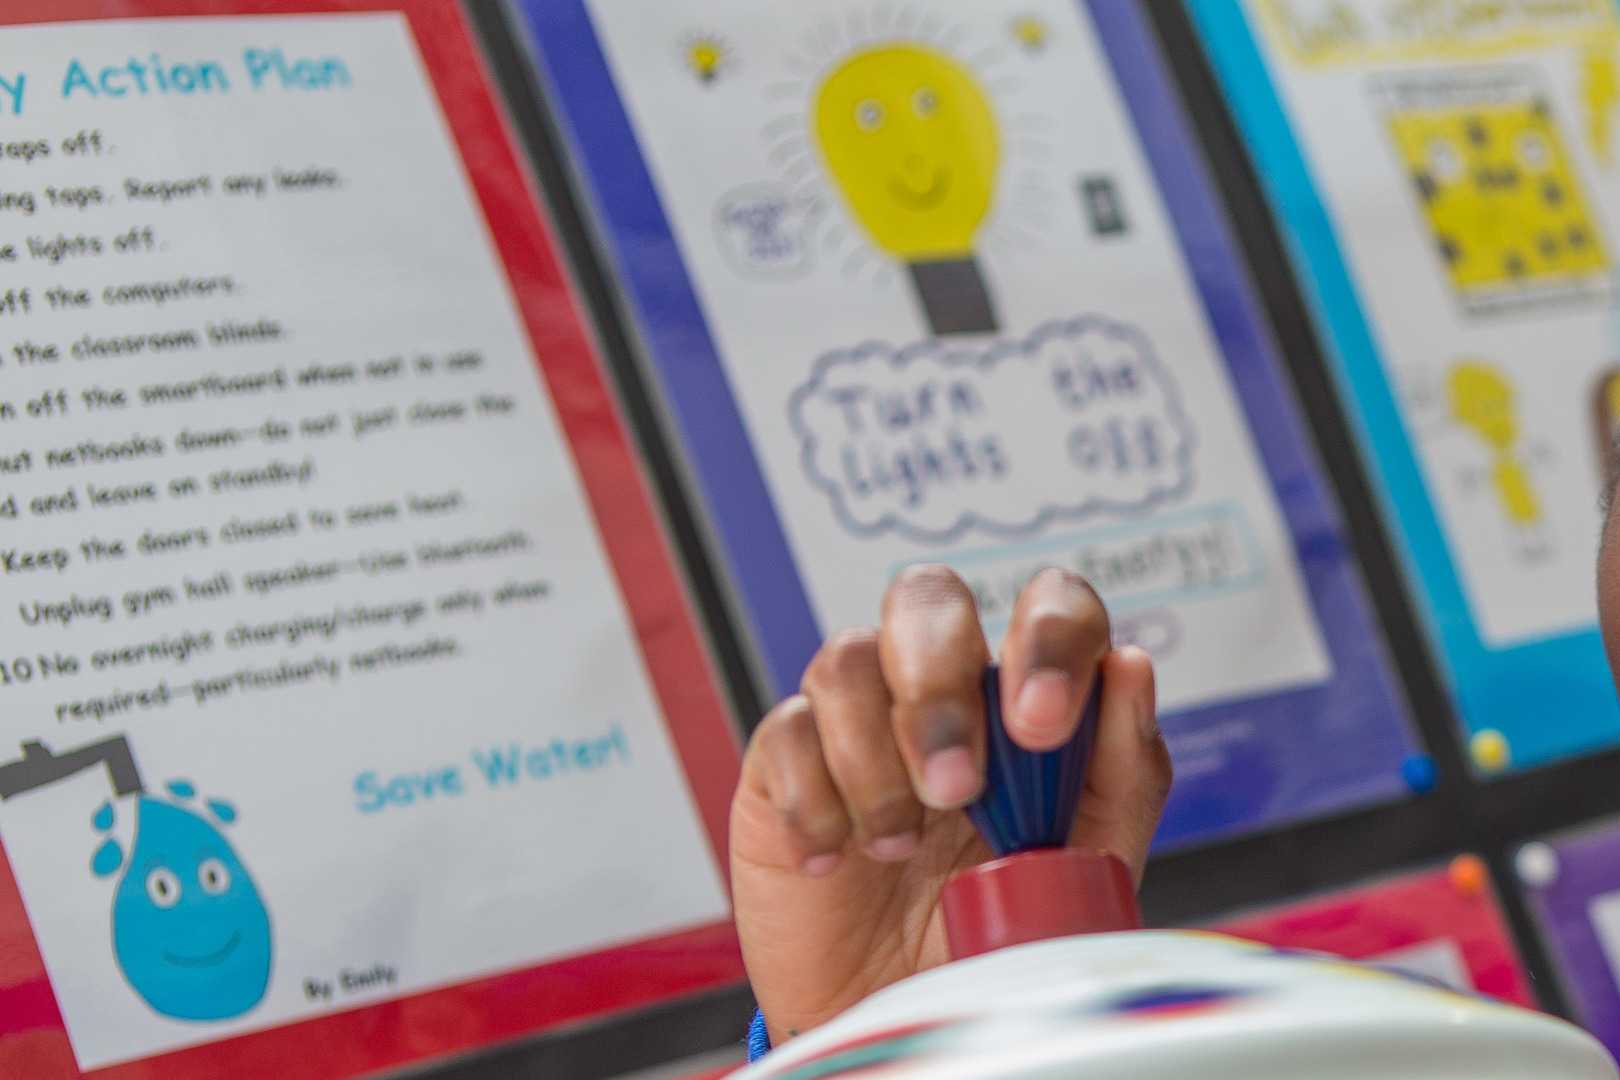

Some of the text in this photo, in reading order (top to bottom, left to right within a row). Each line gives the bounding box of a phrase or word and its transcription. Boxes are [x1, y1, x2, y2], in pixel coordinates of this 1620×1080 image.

[62, 53, 230, 98] Action
[242, 47, 351, 90] Plan
[0, 140, 50, 163] aps
[0, 193, 36, 215] ng
[124, 176, 211, 203] Report
[223, 176, 266, 196] any
[26, 235, 103, 265] lights
[45, 287, 91, 308] the
[13, 342, 59, 364] the
[71, 333, 199, 358] classroom
[26, 389, 67, 417] off
[81, 387, 127, 409] the
[139, 368, 287, 404] smartboard
[297, 365, 356, 386] when
[365, 357, 404, 379] not
[830, 343, 1141, 432] Turn the
[0, 451, 31, 473] ut
[45, 436, 164, 468] netbooks
[300, 414, 340, 436] not
[30, 488, 78, 515] and
[87, 483, 156, 506] leave
[168, 477, 199, 497] on
[0, 549, 68, 573] Keep
[79, 539, 125, 561] the
[137, 529, 209, 554] doors
[220, 512, 300, 543] closed
[308, 510, 337, 529] to
[346, 502, 399, 525] save
[19, 595, 113, 626] Unplug
[122, 587, 176, 616] gym
[183, 572, 232, 599] hall
[37, 654, 79, 678] No
[91, 631, 213, 666] overnight
[353, 723, 629, 814] Save Water!
